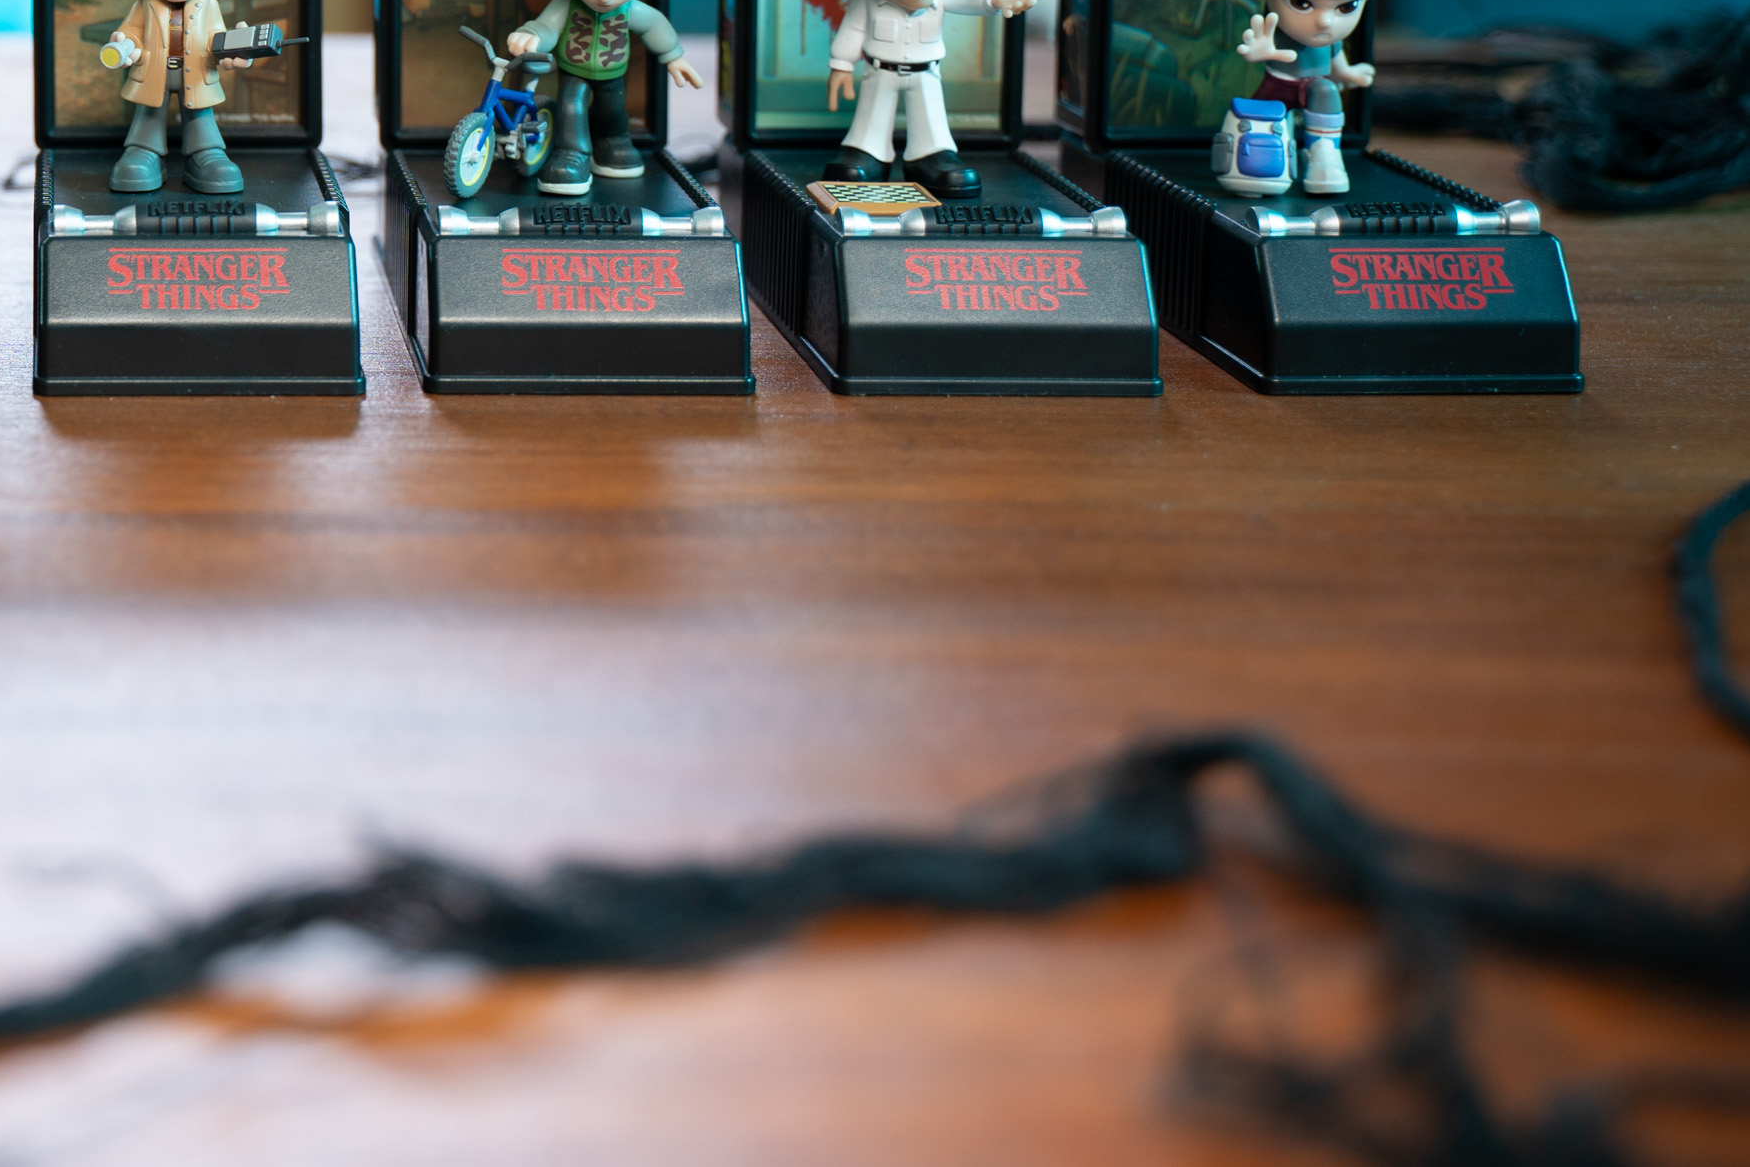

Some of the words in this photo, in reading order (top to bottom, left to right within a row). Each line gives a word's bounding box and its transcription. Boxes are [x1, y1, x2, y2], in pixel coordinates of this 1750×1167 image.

[148, 201, 244, 216] NETFLIX
[532, 203, 631, 225] NETFLIX
[934, 205, 1033, 224] NETFLIX
[107, 253, 290, 288] STRANGER
[501, 253, 685, 289] STRANGER
[905, 254, 1089, 289] STRANGER
[1330, 253, 1513, 288] STRANGER
[135, 283, 261, 311] THINGS
[529, 284, 656, 312] THINGS
[934, 284, 1061, 312] THINGS
[1361, 283, 1487, 311] THINGS
